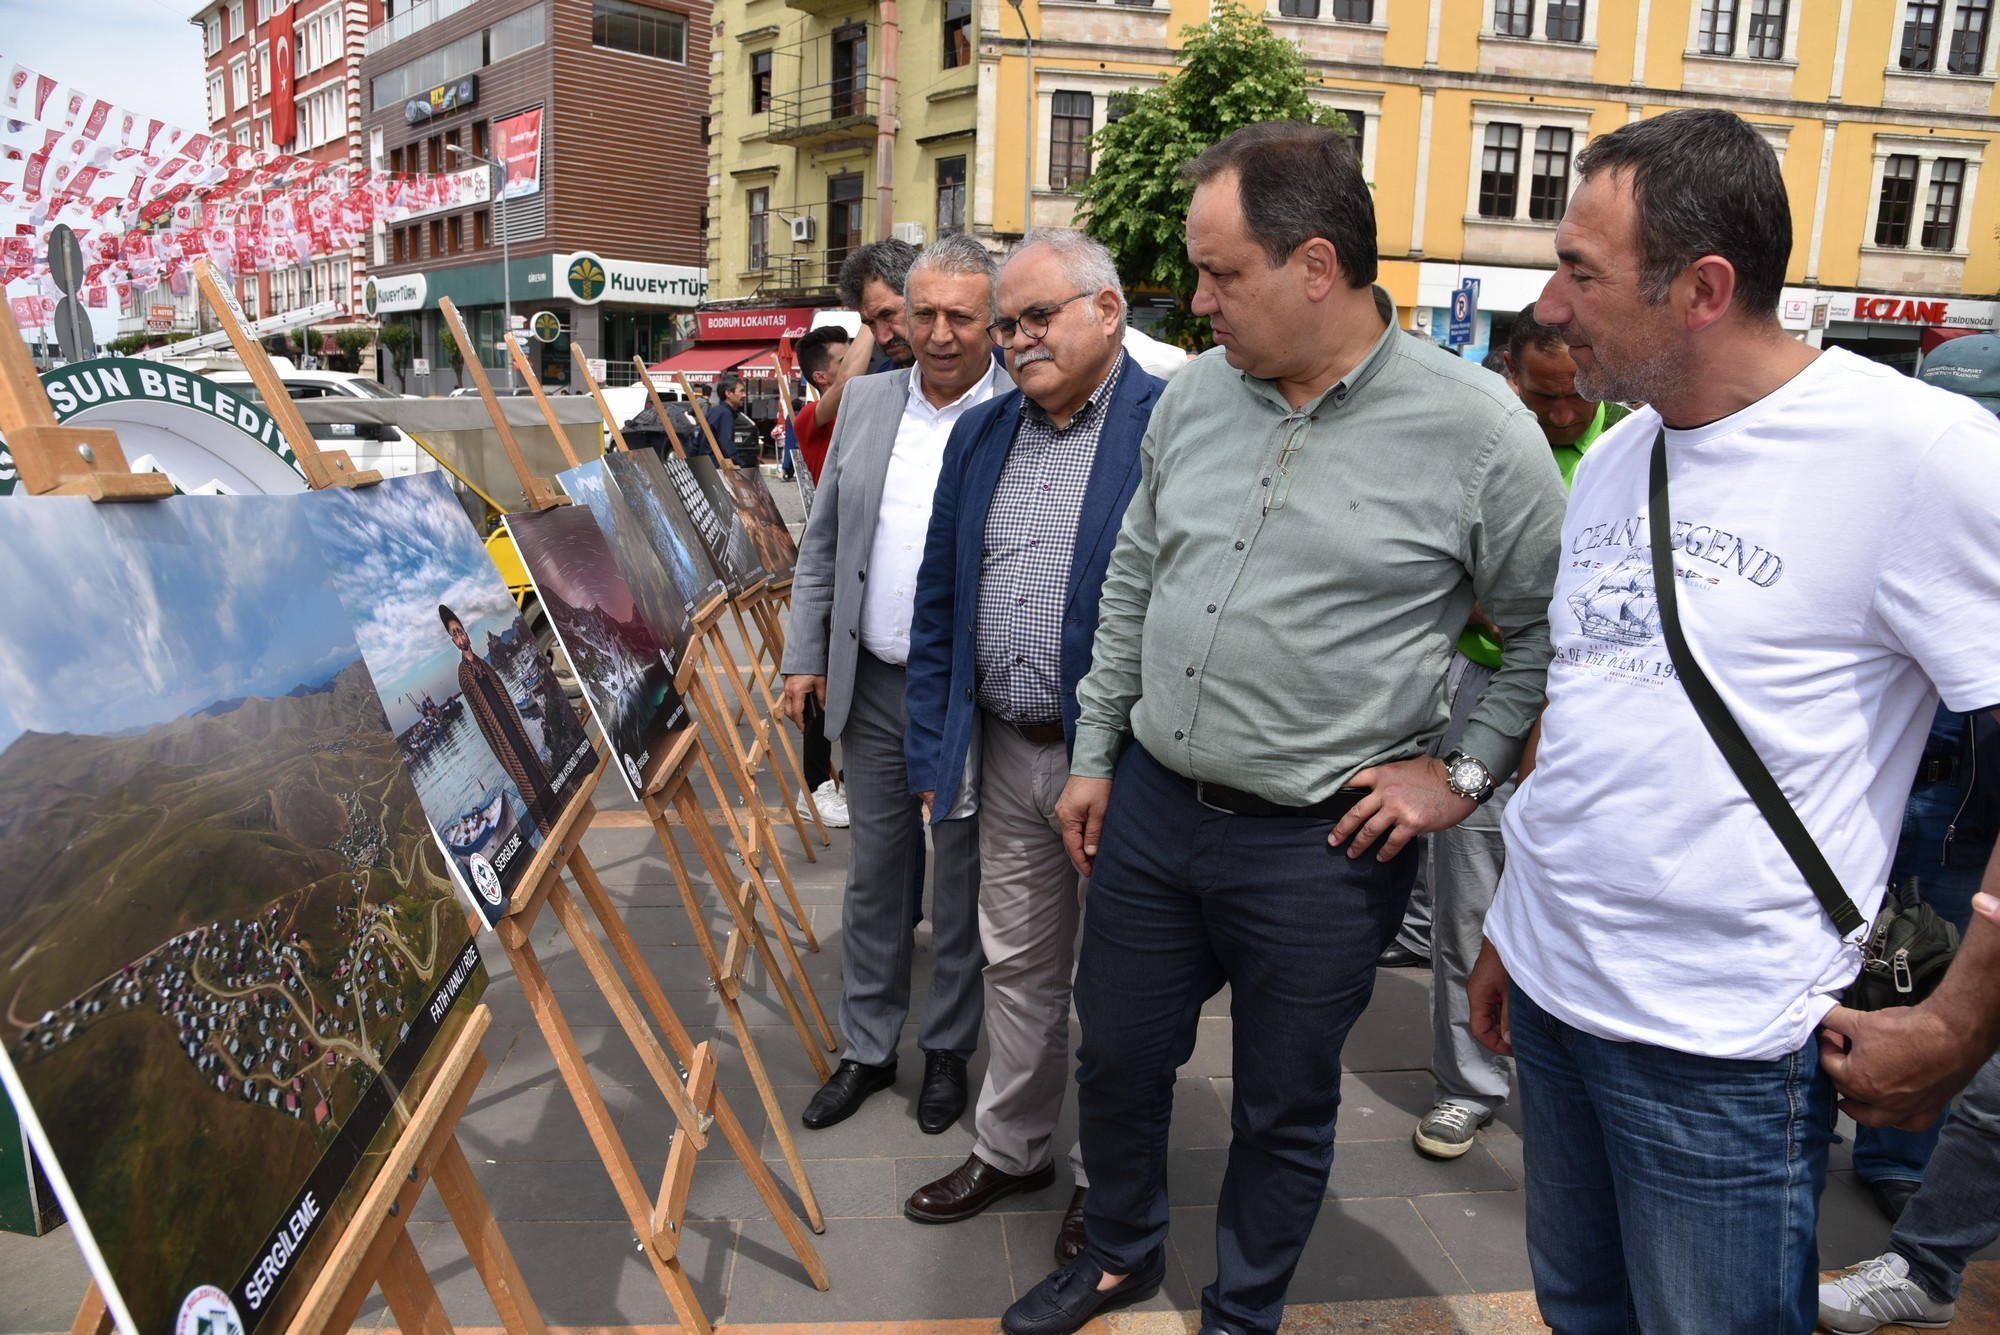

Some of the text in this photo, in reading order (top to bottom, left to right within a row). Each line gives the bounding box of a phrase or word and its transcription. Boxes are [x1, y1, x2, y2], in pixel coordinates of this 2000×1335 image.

[249, 29, 260, 120] HOTEL
[708, 315, 787, 328] BODRUM LOKANTASI
[1854, 297, 1948, 323] ECZANE
[686, 374, 713, 383] KANTASI
[743, 370, 752, 378] 24
[752, 370, 770, 378] SAAT
[47, 368, 302, 474] SUN BELEDİY
[1572, 517, 1785, 588] CEAN EGEND
[1569, 647, 1581, 661] OF
[1585, 651, 1608, 667] THE
[1607, 656, 1648, 673] OCEAN
[494, 832, 522, 872] SERGİLEME
[430, 987, 451, 1024] FATİH
[445, 965, 465, 997] VANLI
[463, 944, 478, 971] RİZE
[245, 1190, 320, 1310] SERGİLEME
